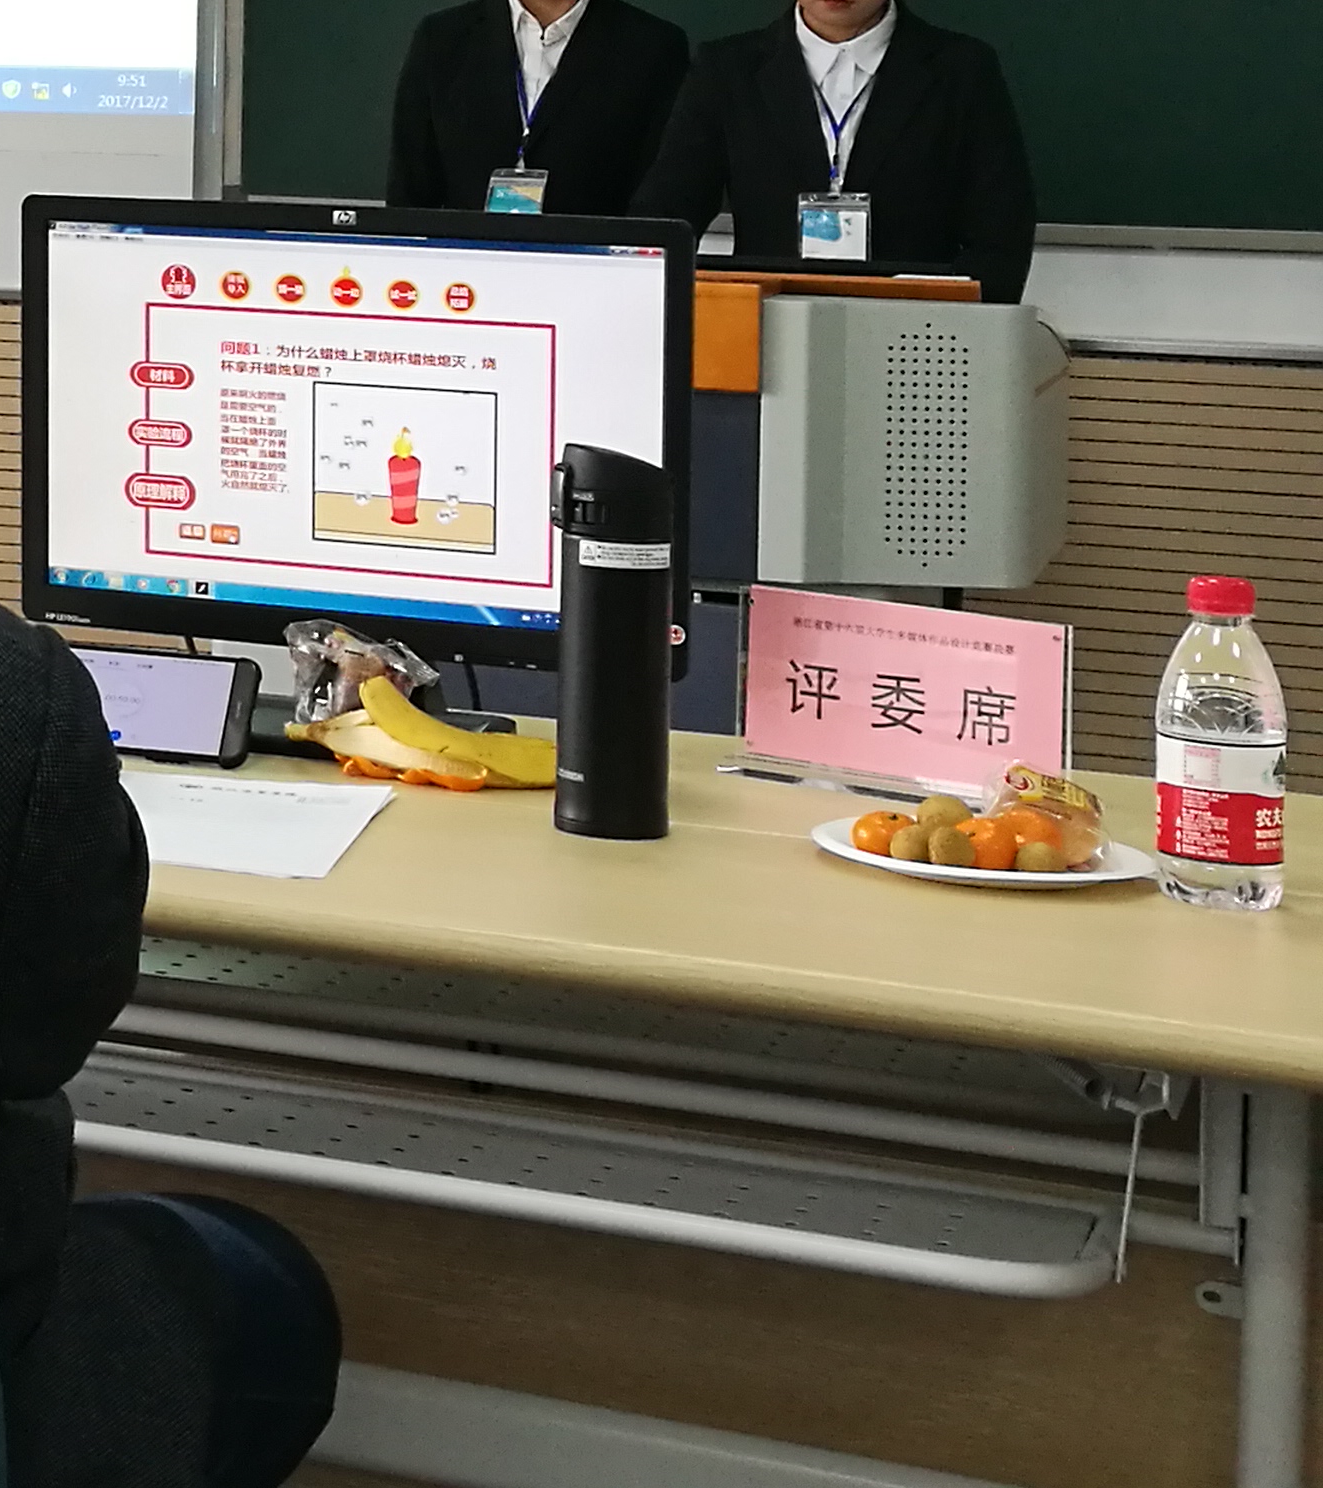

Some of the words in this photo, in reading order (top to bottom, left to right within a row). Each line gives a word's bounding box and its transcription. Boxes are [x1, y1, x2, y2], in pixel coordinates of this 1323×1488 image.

[116, 74, 147, 88] 9:51
[97, 93, 169, 110] 2017/12/2
[785, 658, 1018, 748] 评委席
